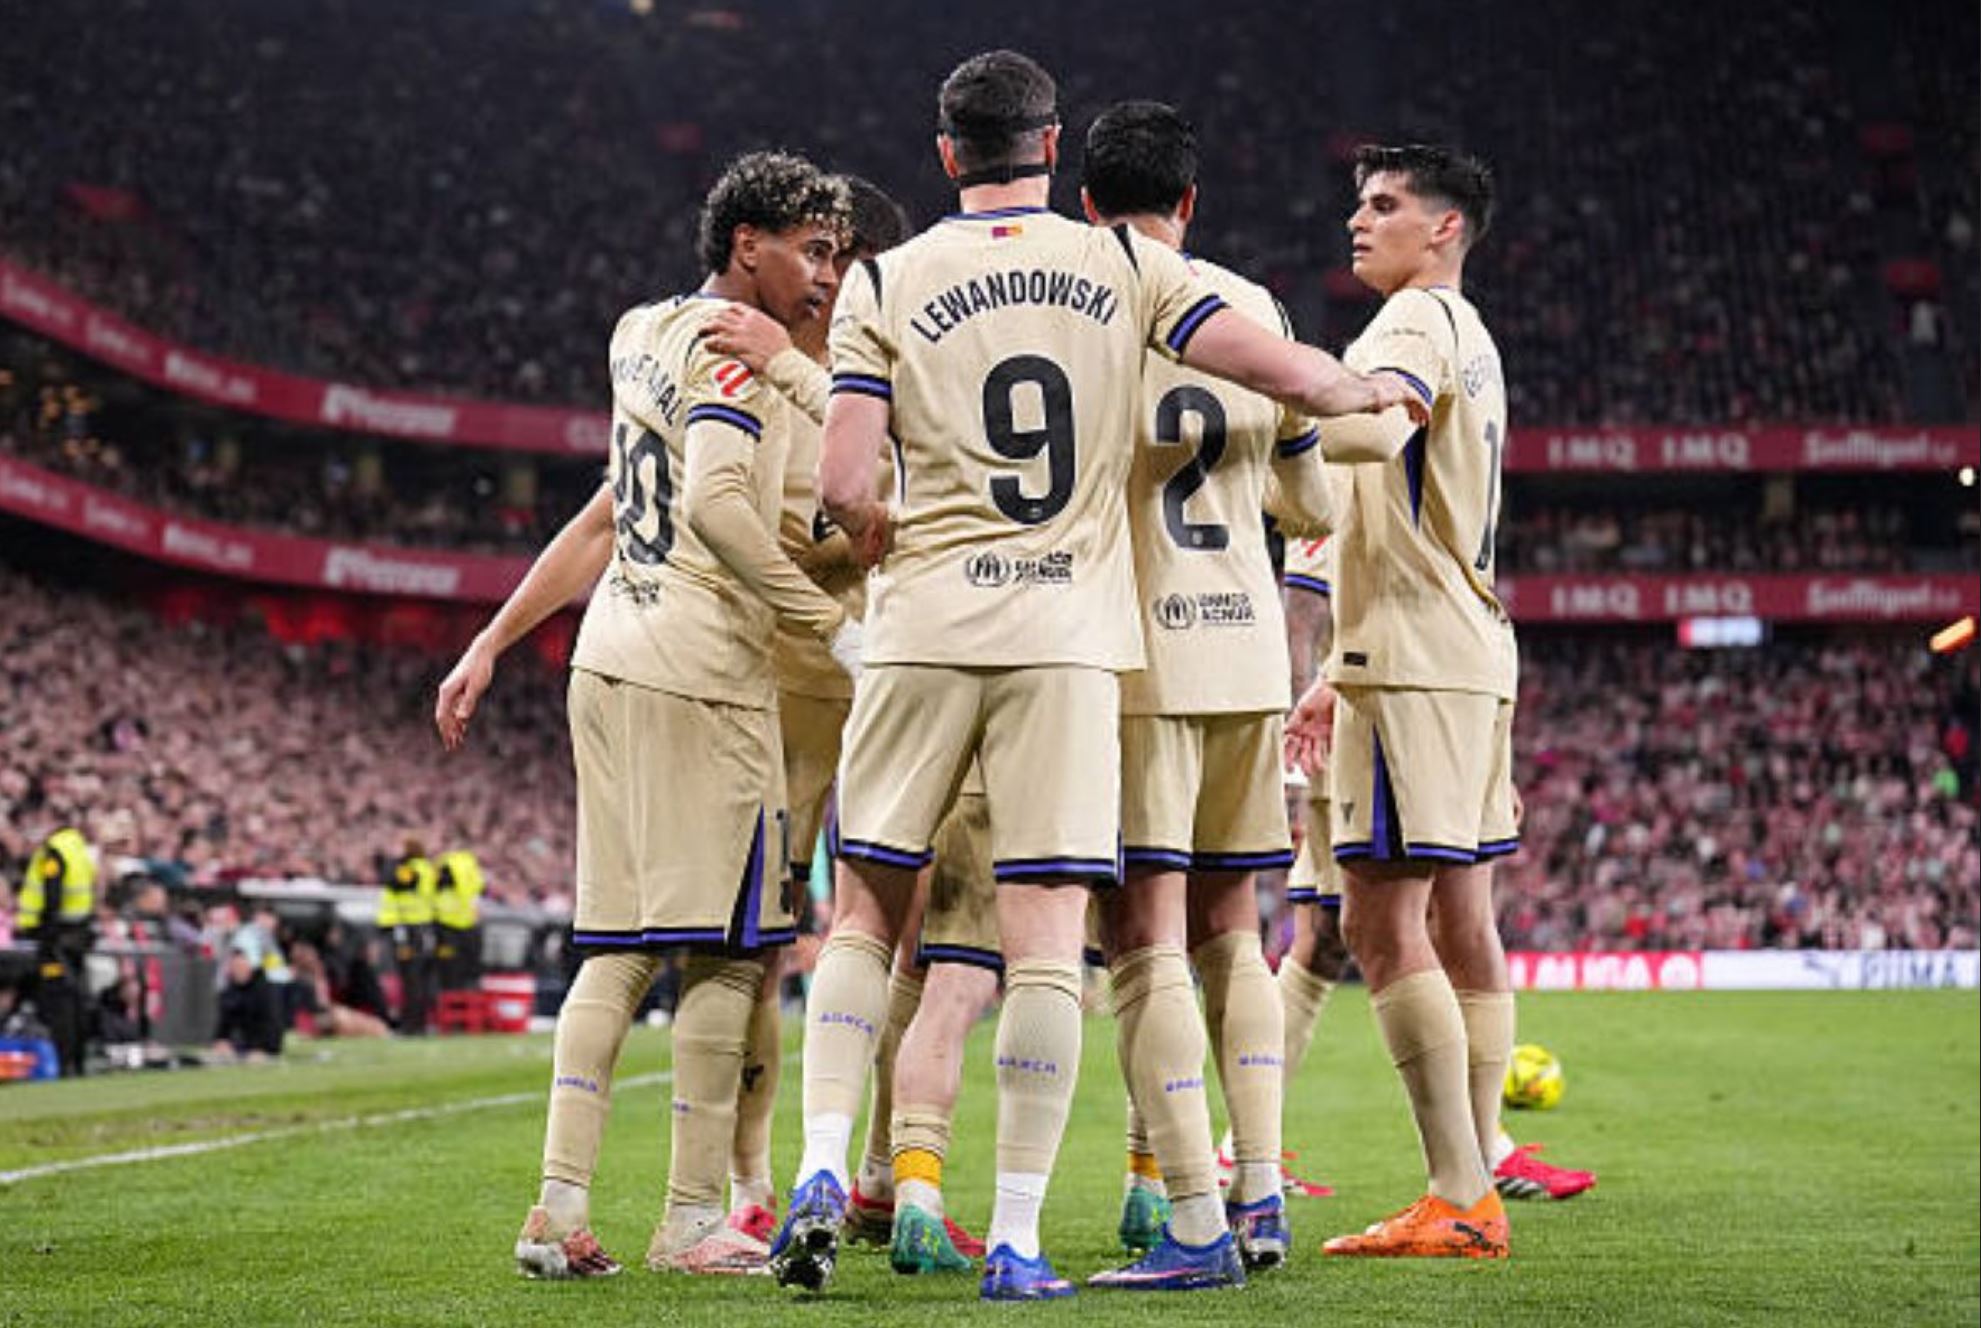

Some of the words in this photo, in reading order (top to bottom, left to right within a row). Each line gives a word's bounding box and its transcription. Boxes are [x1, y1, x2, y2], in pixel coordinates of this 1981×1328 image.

[910, 269, 1118, 343] LEWANDOWSKI
[983, 354, 1076, 524] 9
[1156, 384, 1230, 549] 2
[1549, 435, 1636, 469] IMQ
[1662, 435, 1749, 469] IMQ
[1552, 583, 1640, 618] IMQ
[1665, 582, 1752, 617] IMQ
